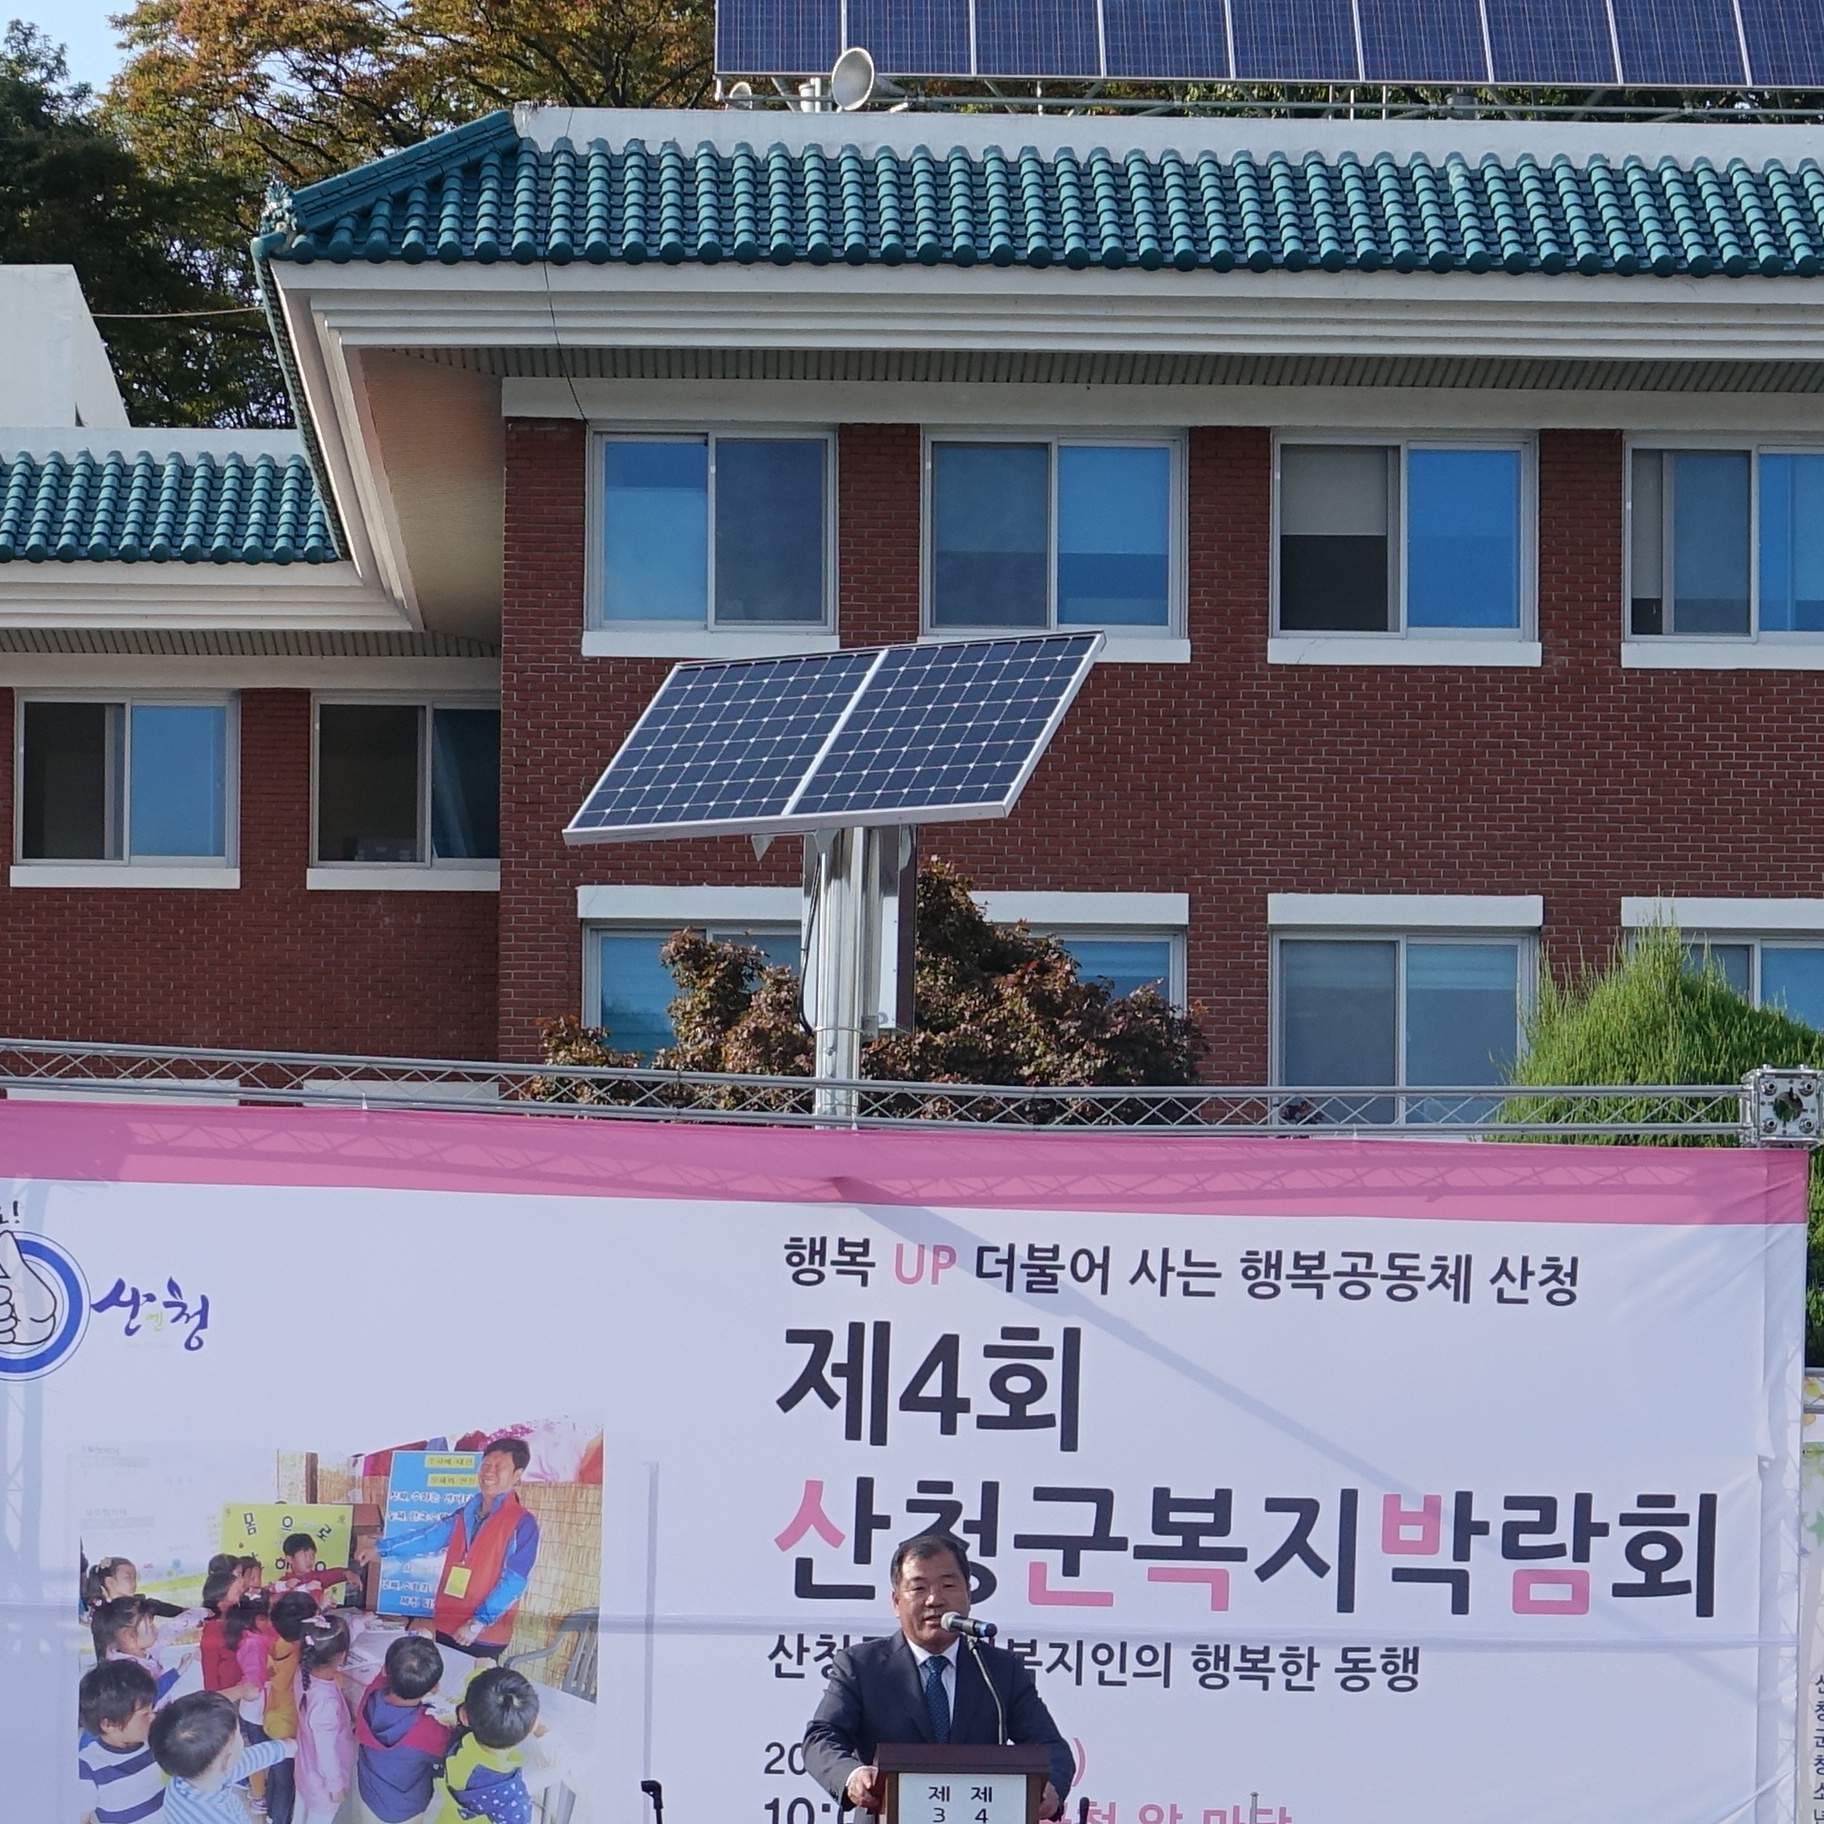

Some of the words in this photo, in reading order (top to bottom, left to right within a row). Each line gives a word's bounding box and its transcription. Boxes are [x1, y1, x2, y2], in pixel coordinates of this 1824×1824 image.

[784, 1237, 876, 1289] 행복
[893, 1244, 957, 1285] UP
[975, 1242, 1110, 1296] 더불어
[1128, 1247, 1222, 1299] 사는
[1239, 1250, 1472, 1306] 행복공동체
[1488, 1255, 1581, 1308] 산청
[775, 1320, 1082, 1452] 제4회
[1191, 1644, 1321, 1692] 행복한
[1333, 1646, 1422, 1694] 동행
